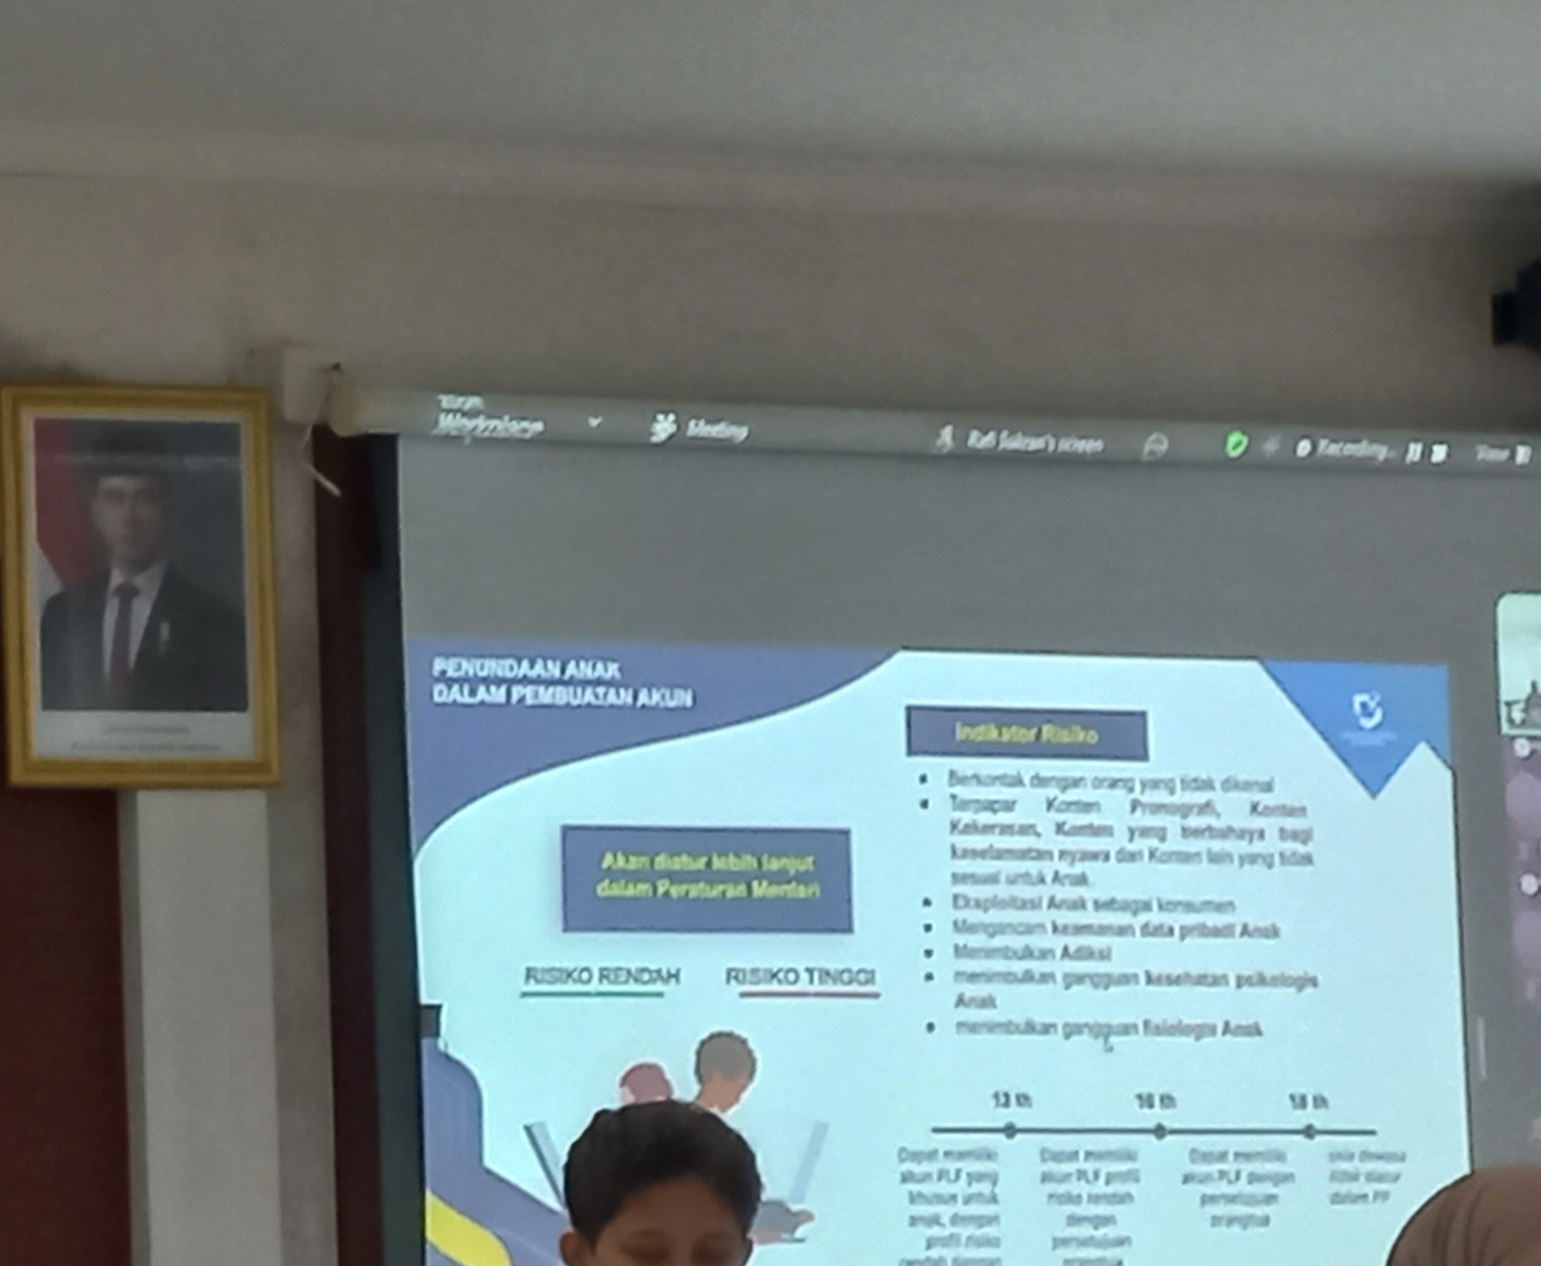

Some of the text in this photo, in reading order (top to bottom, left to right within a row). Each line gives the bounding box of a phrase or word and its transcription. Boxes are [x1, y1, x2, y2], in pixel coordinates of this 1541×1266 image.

[433, 657, 621, 679] PENUNDAAN ANAK
[433, 685, 693, 709] DALAM PEMBUATAN AKUN
[955, 722, 1098, 745] Indikator Risiko
[524, 967, 681, 986] RISIKO RENDAH
[725, 968, 877, 986] RISIKO TINGGI
